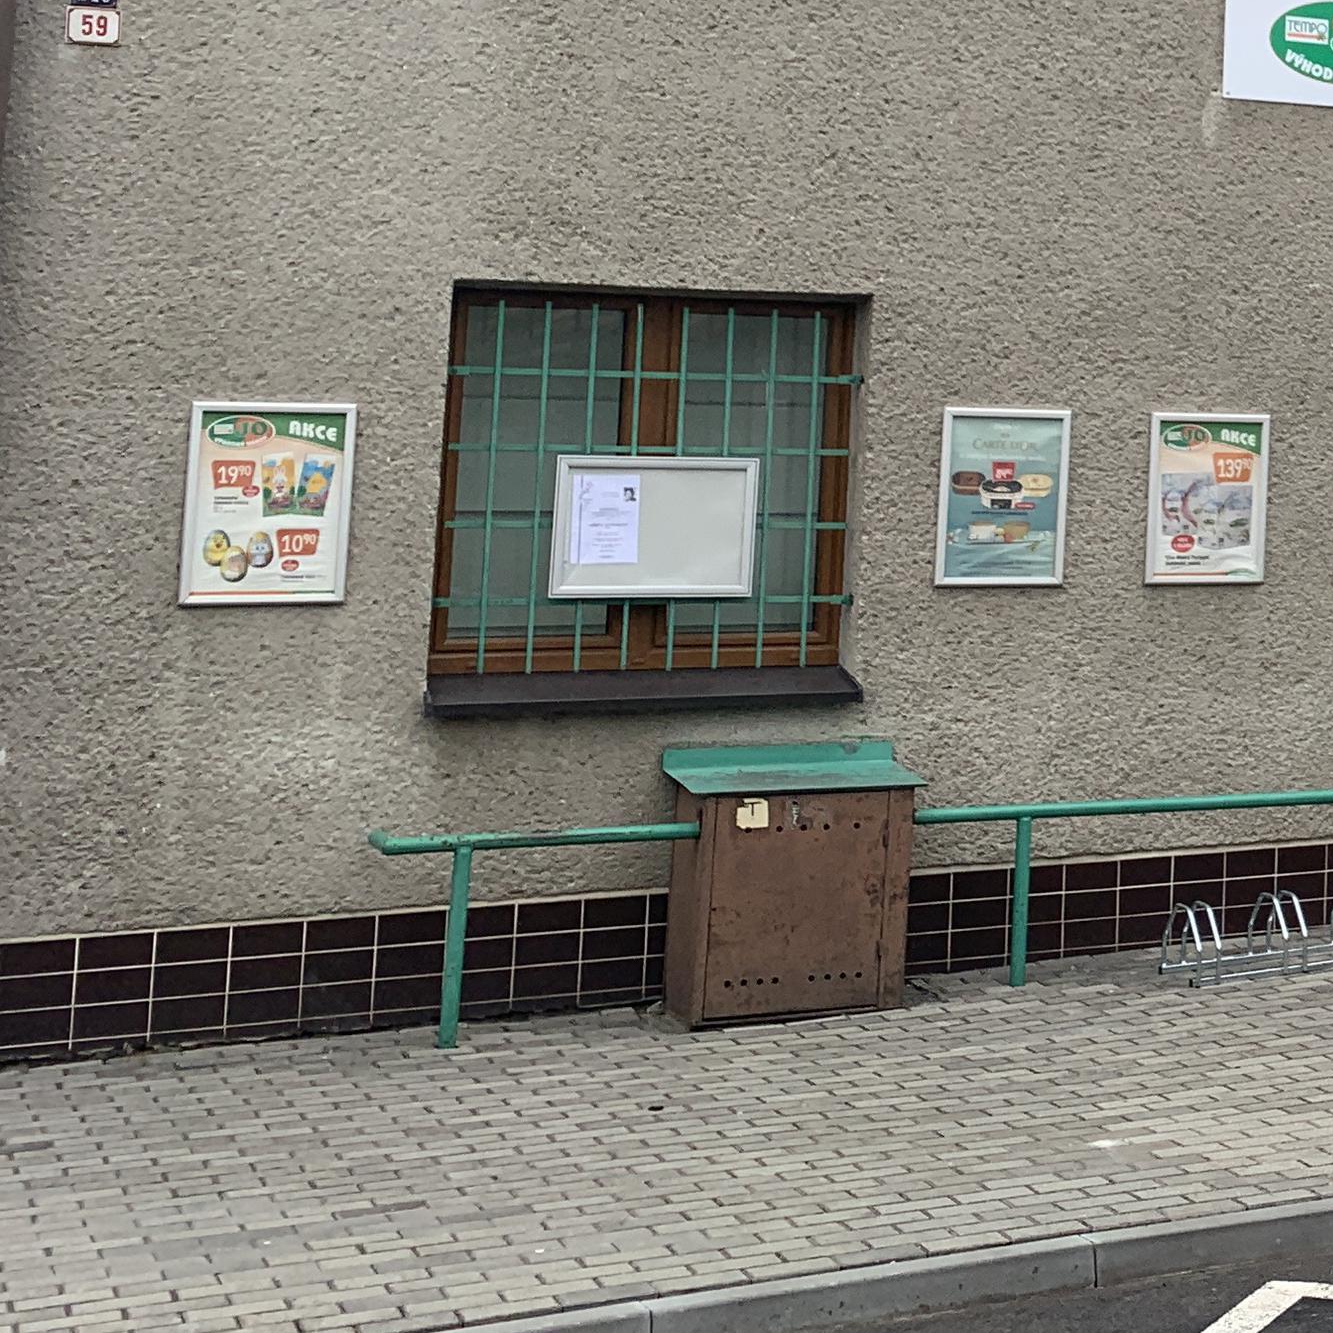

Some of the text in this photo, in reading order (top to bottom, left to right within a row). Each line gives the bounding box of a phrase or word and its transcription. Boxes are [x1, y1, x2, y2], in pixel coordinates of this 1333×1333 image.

[81, 14, 108, 36] 59
[1287, 20, 1328, 33] TEMPO
[288, 420, 338, 443] AKCE
[1220, 428, 1257, 447] AKCE
